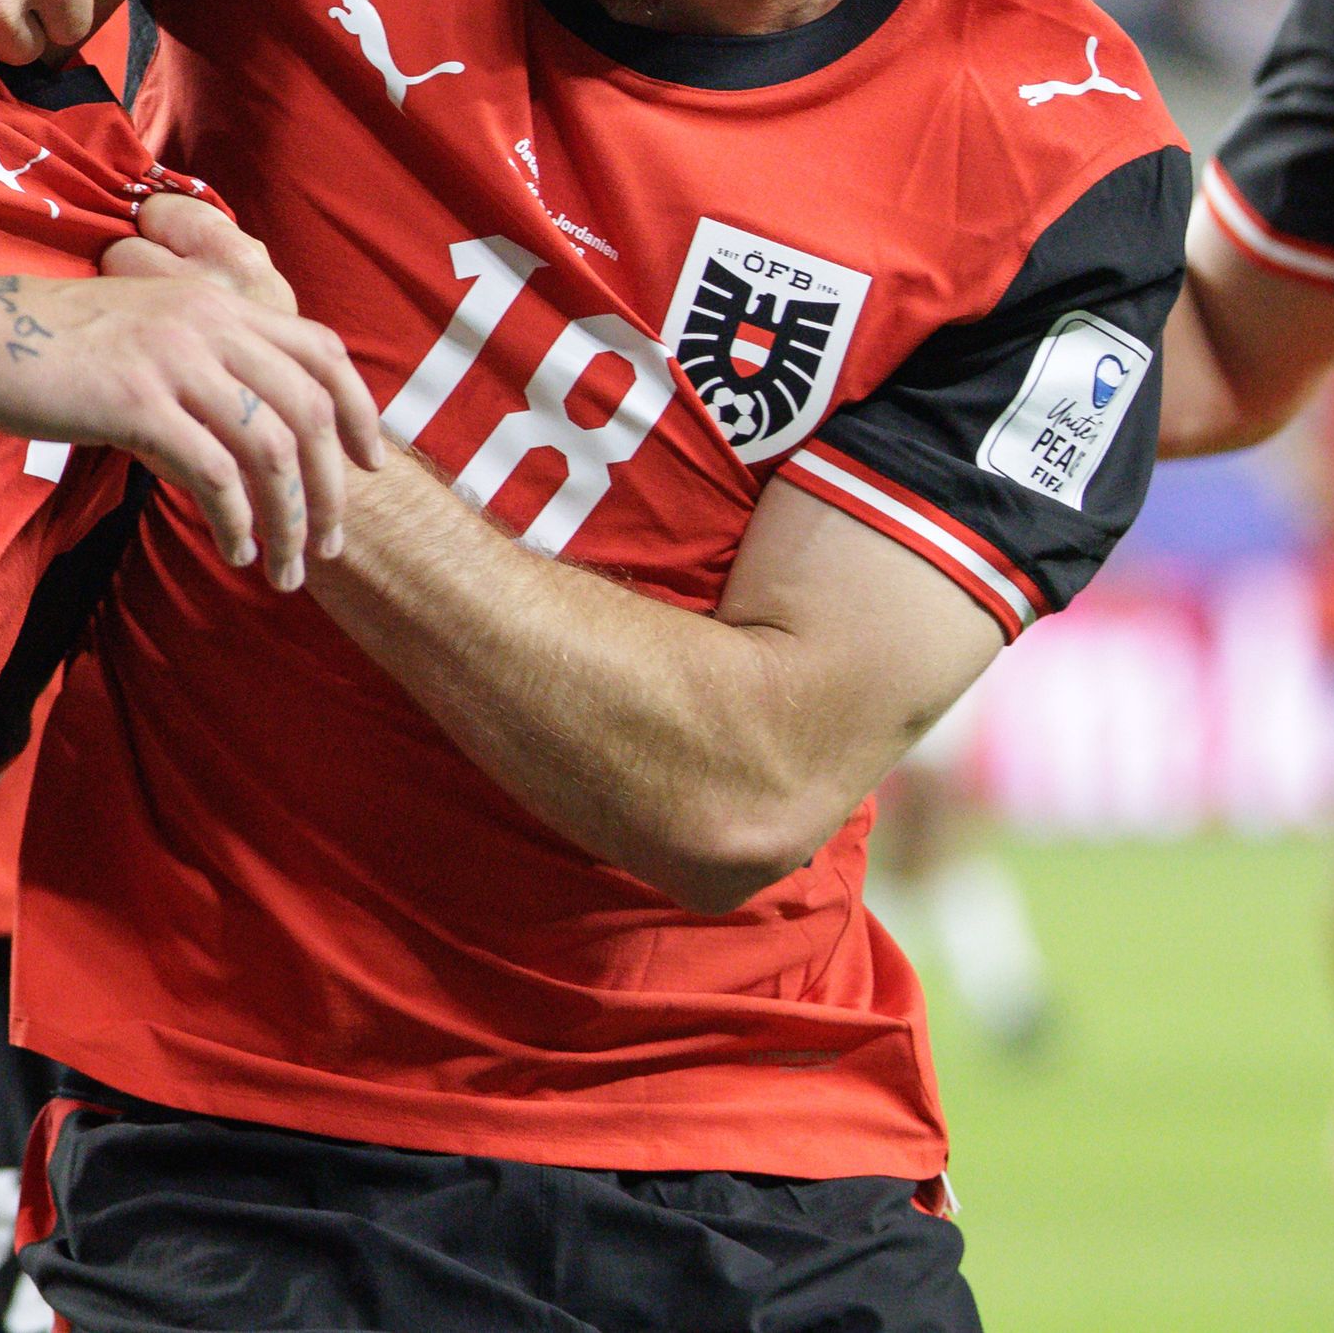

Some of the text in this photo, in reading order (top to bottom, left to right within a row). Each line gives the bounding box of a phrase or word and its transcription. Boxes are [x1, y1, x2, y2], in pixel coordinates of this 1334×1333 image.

[551, 213, 619, 262] Jordanien
[716, 247, 740, 261] SEIT
[743, 249, 813, 291] ÖFB
[379, 234, 677, 556] 18
